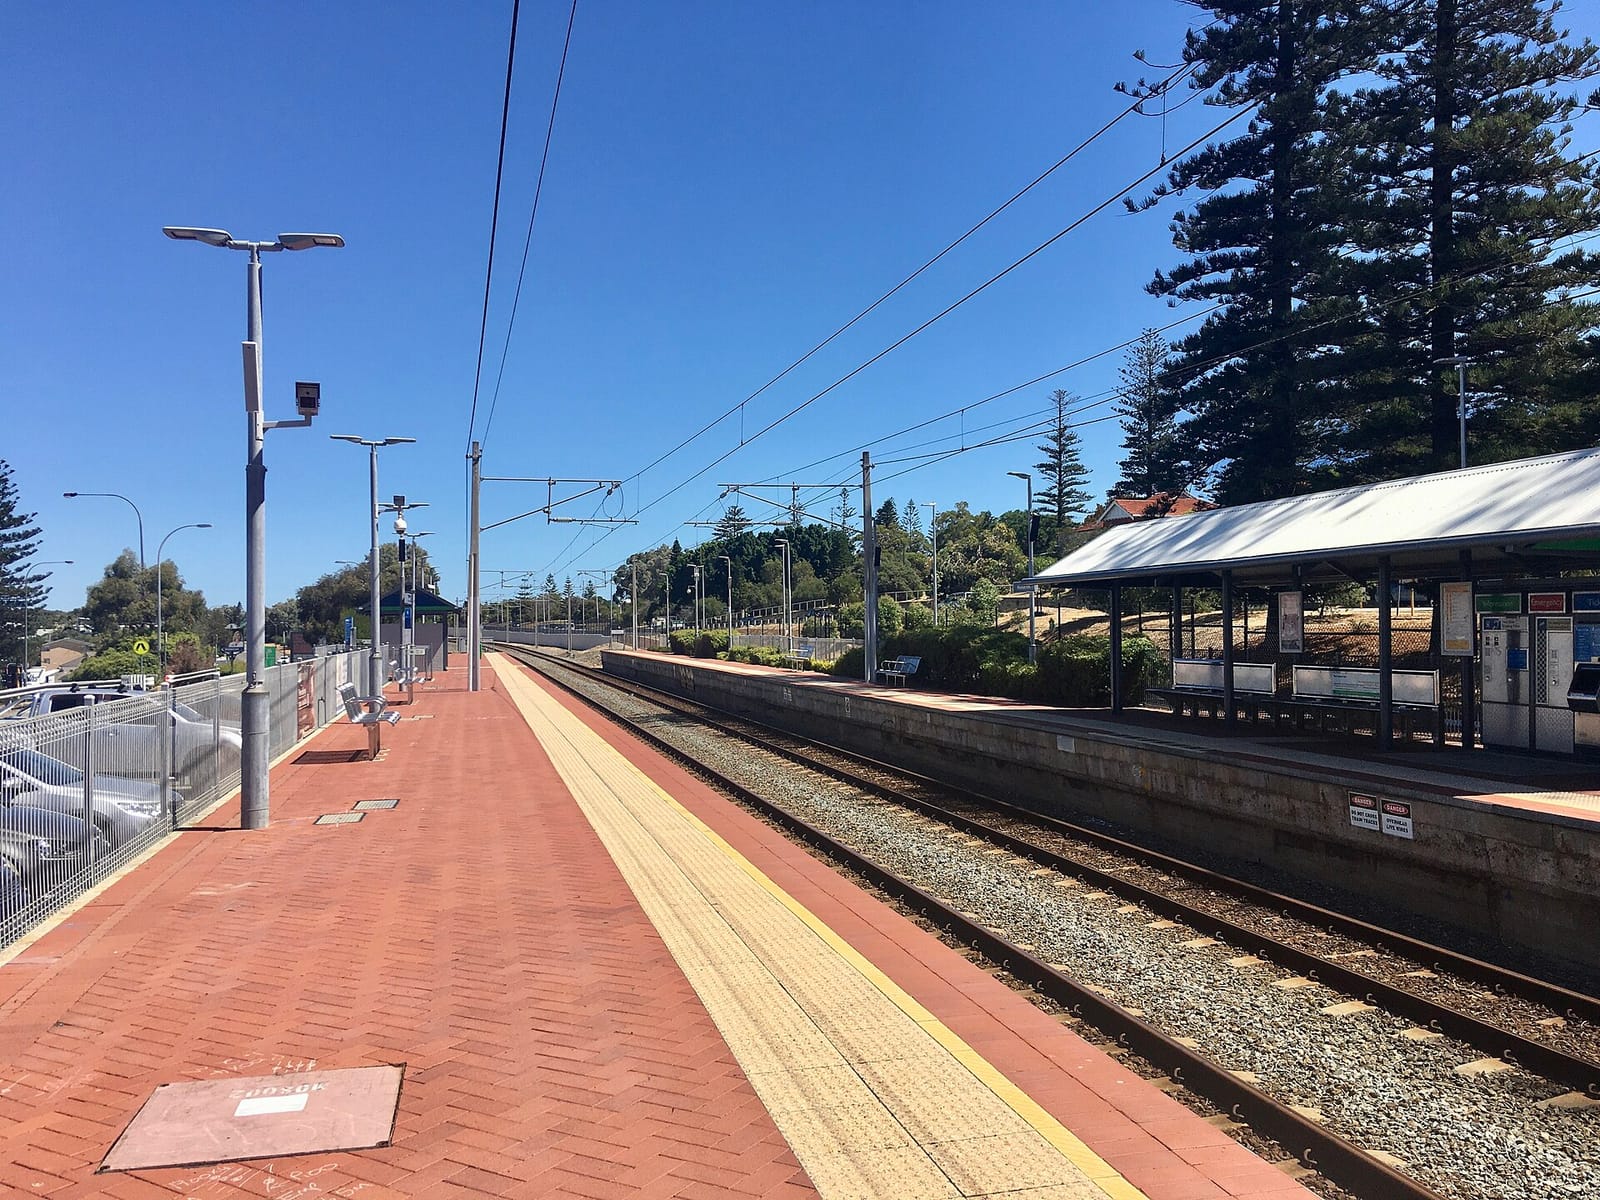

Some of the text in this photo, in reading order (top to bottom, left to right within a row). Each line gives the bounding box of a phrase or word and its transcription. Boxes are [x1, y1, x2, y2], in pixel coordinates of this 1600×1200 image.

[1354, 797, 1372, 805] DANGER
[1386, 804, 1405, 812] DANGER
[1363, 818, 1378, 826] TRACKS
[1386, 818, 1407, 826] OVERHEAD
